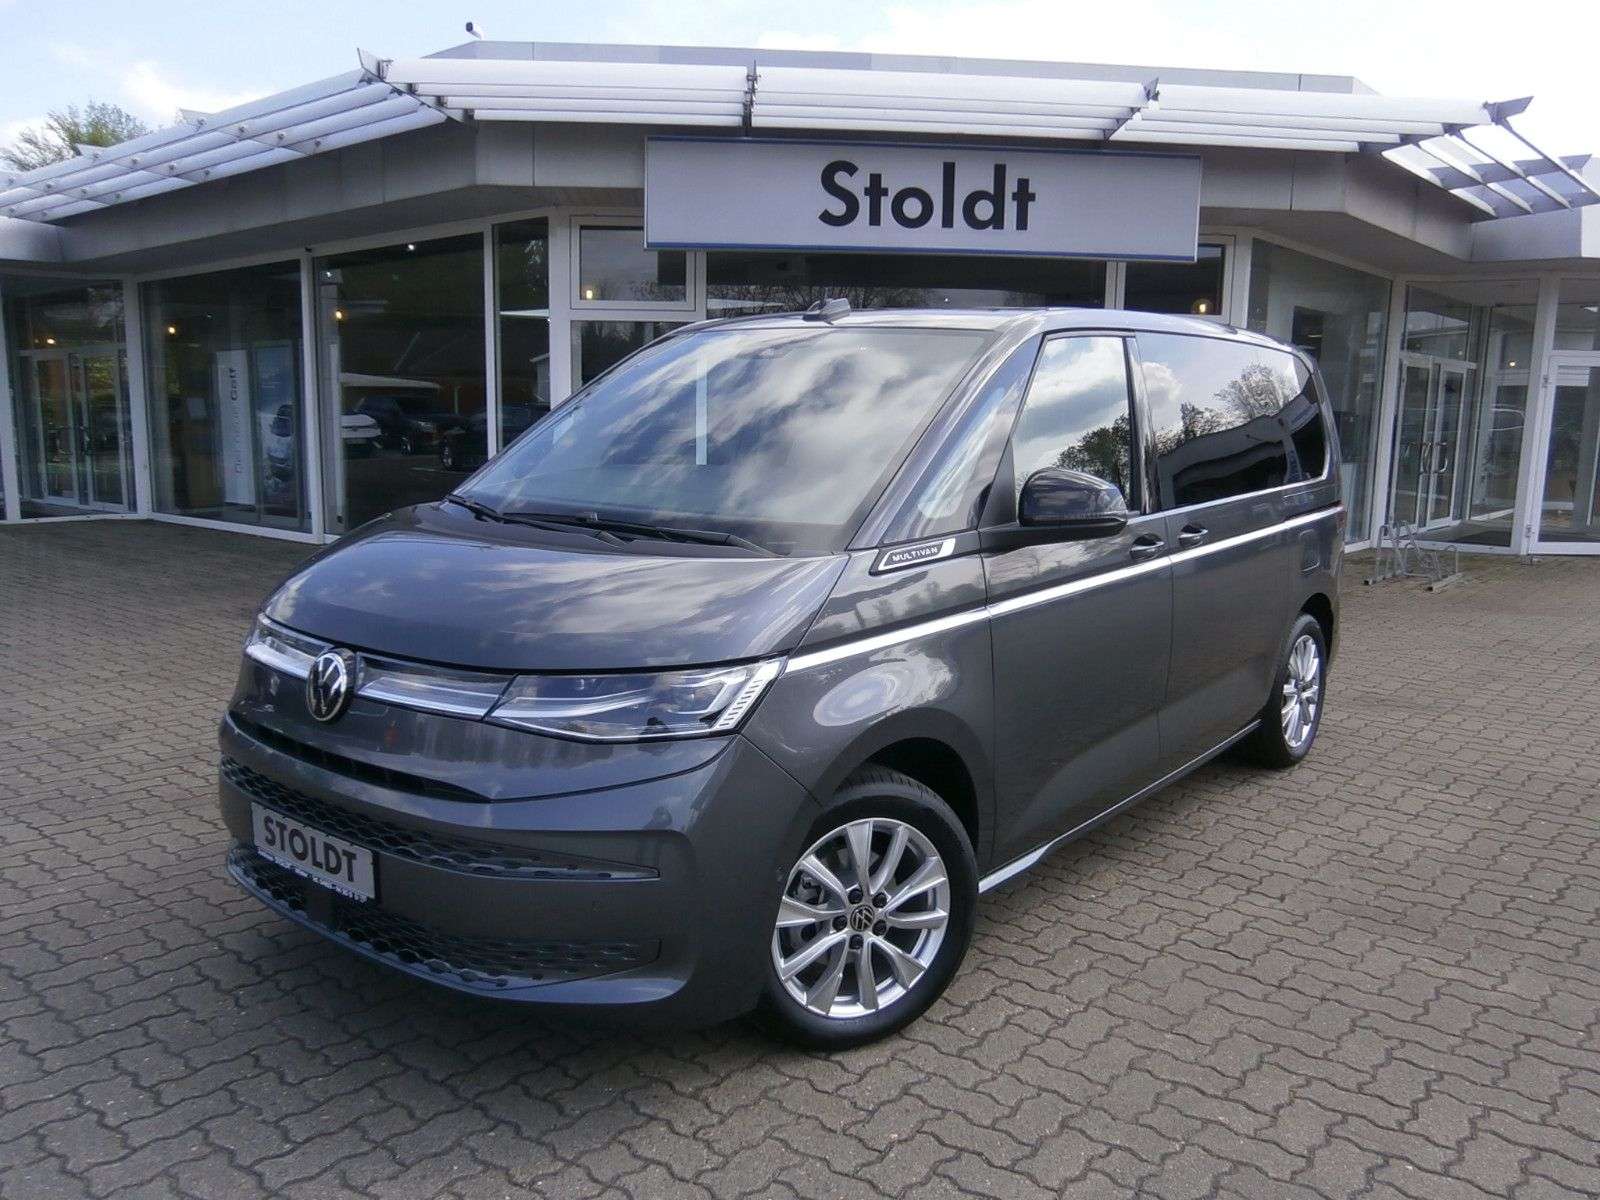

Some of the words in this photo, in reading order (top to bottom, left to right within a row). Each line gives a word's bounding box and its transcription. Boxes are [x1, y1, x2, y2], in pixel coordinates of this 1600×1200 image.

[818, 160, 1036, 231] Stoldt
[892, 546, 938, 562] MULTIVAN
[263, 815, 357, 883] STOLDT
